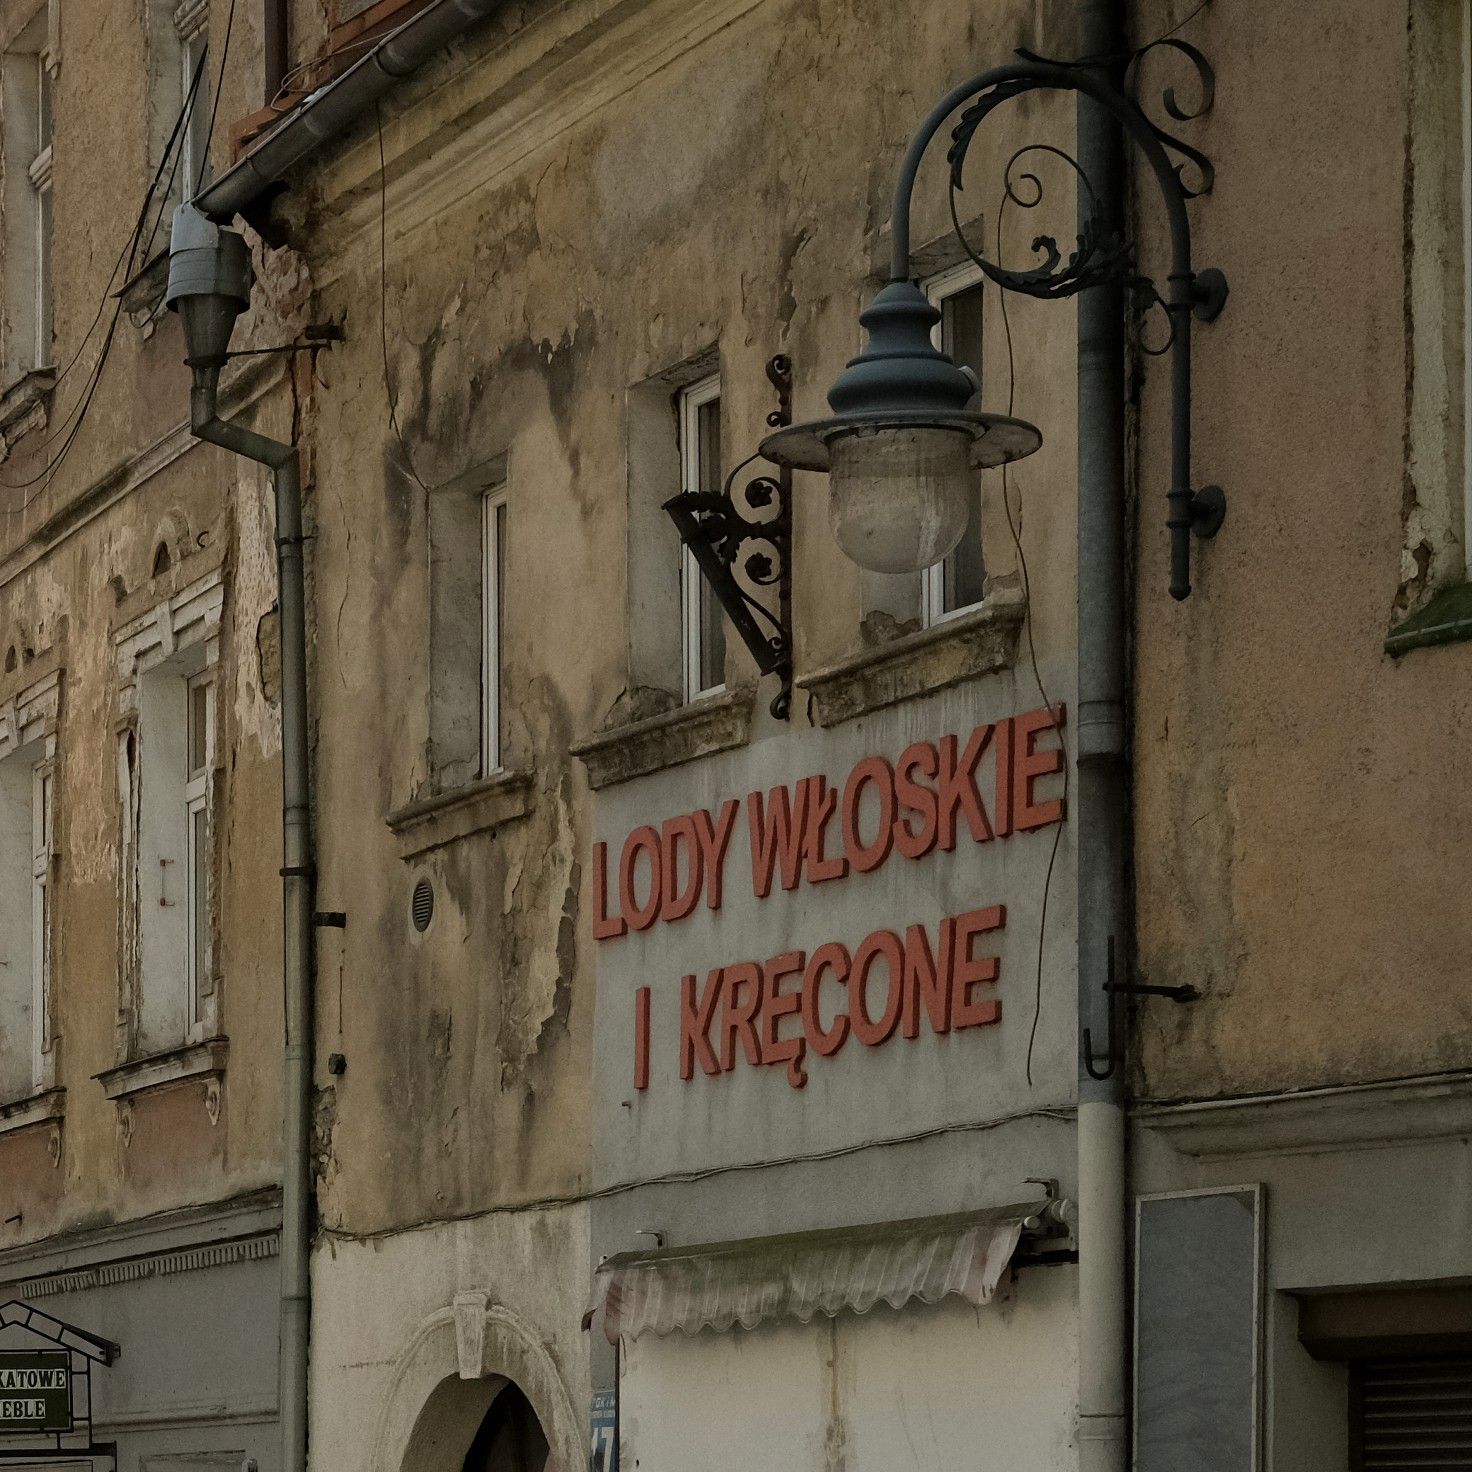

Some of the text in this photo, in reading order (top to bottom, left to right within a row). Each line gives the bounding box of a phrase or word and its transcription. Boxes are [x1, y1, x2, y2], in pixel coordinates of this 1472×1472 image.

[593, 702, 1067, 939] LODY WŁOSKIE
[633, 904, 1006, 1089] I KRĘCONE
